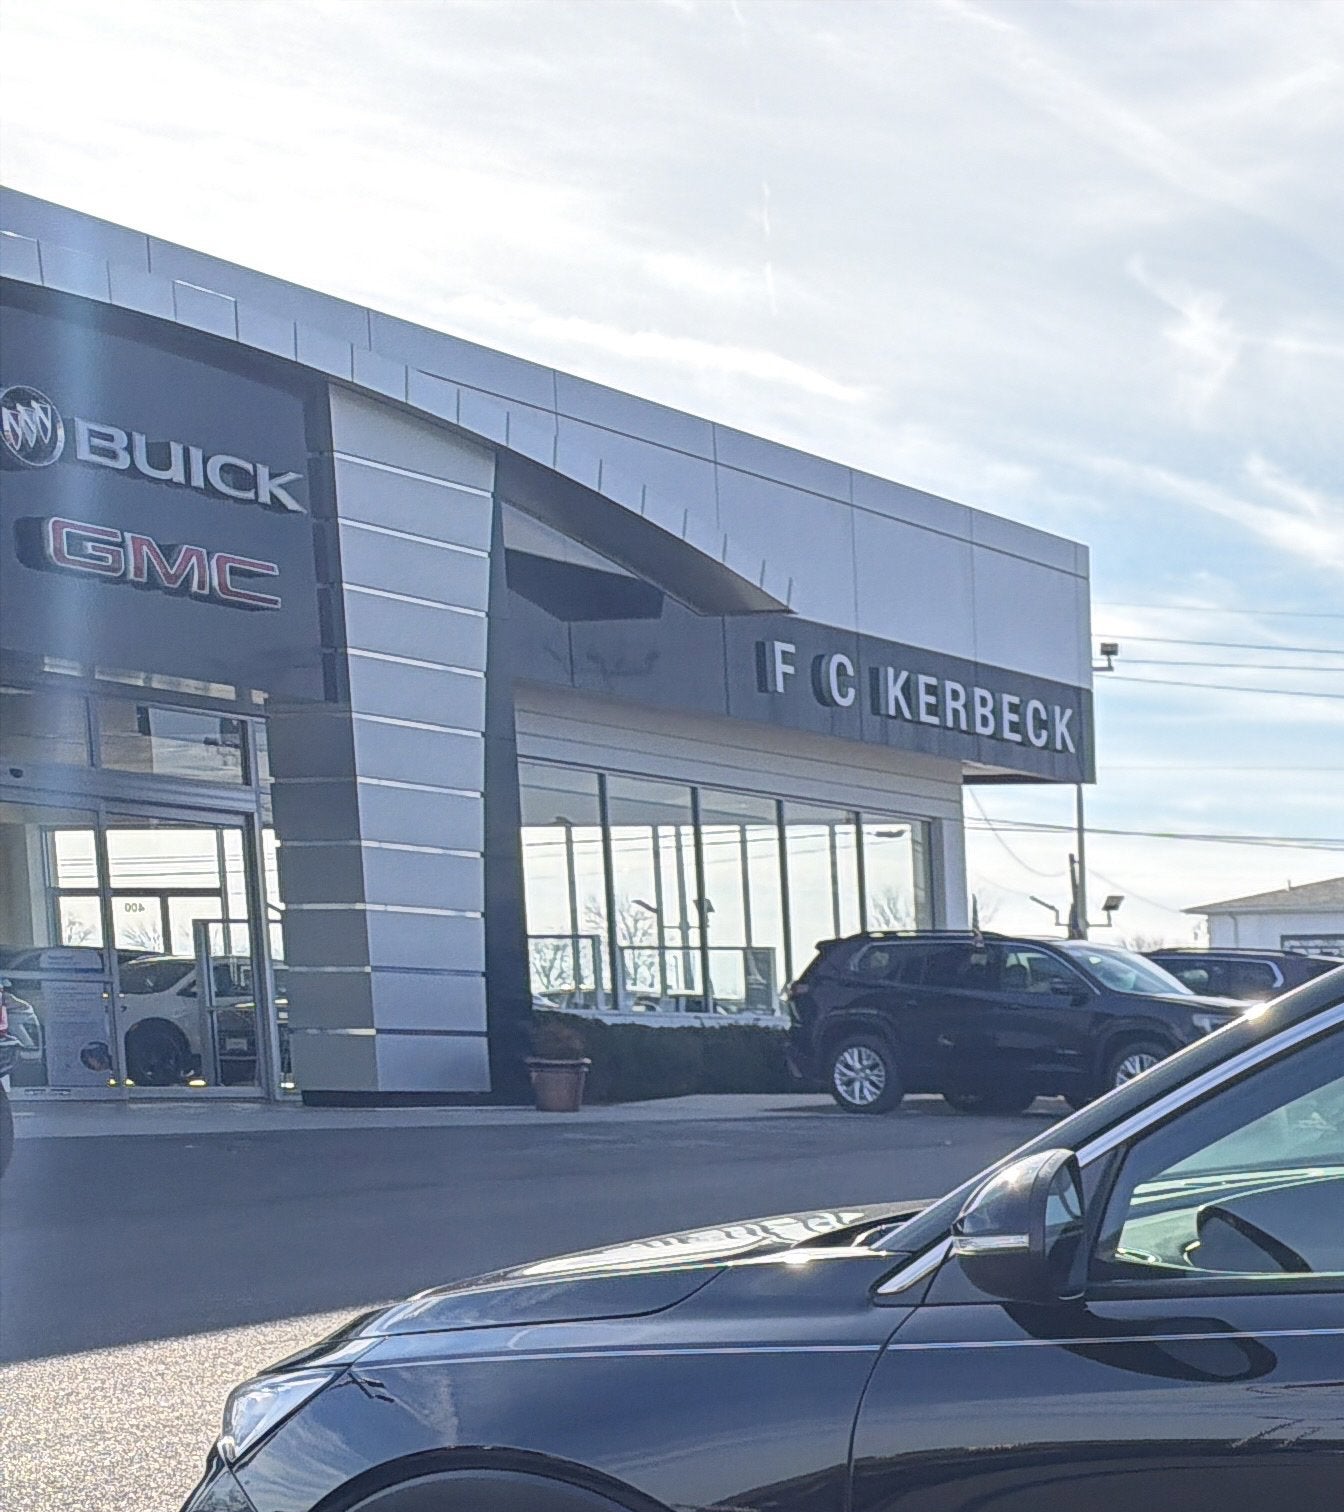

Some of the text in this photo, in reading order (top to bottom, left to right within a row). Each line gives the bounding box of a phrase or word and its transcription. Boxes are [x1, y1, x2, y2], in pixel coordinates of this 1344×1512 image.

[74, 417, 308, 514] BUICK
[48, 516, 282, 609] GMC
[772, 640, 1077, 754] F C KERBECK
